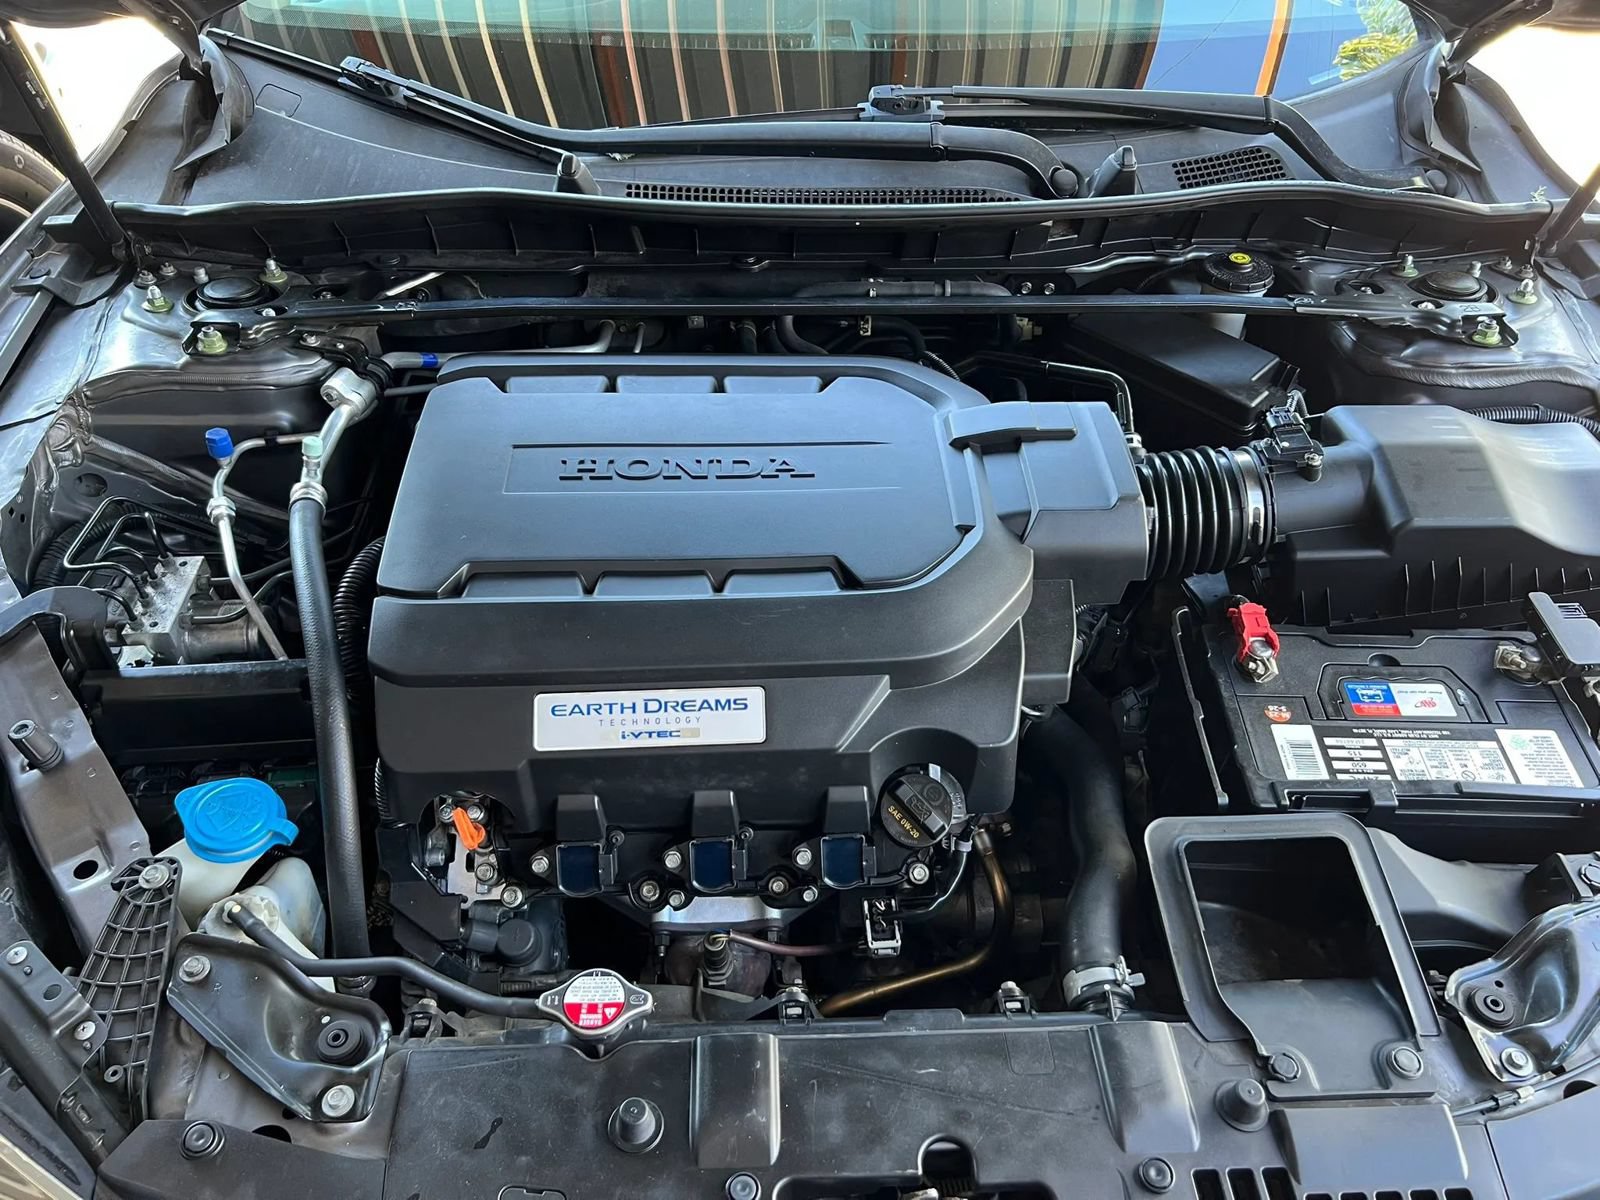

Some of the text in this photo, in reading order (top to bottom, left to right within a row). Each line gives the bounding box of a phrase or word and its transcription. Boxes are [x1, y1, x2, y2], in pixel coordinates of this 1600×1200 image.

[559, 456, 815, 481] HONDA
[551, 697, 748, 717] EARTH DREAMS
[599, 716, 701, 727] TECHNOLOGY
[887, 805, 920, 839] SAE 0W-20
